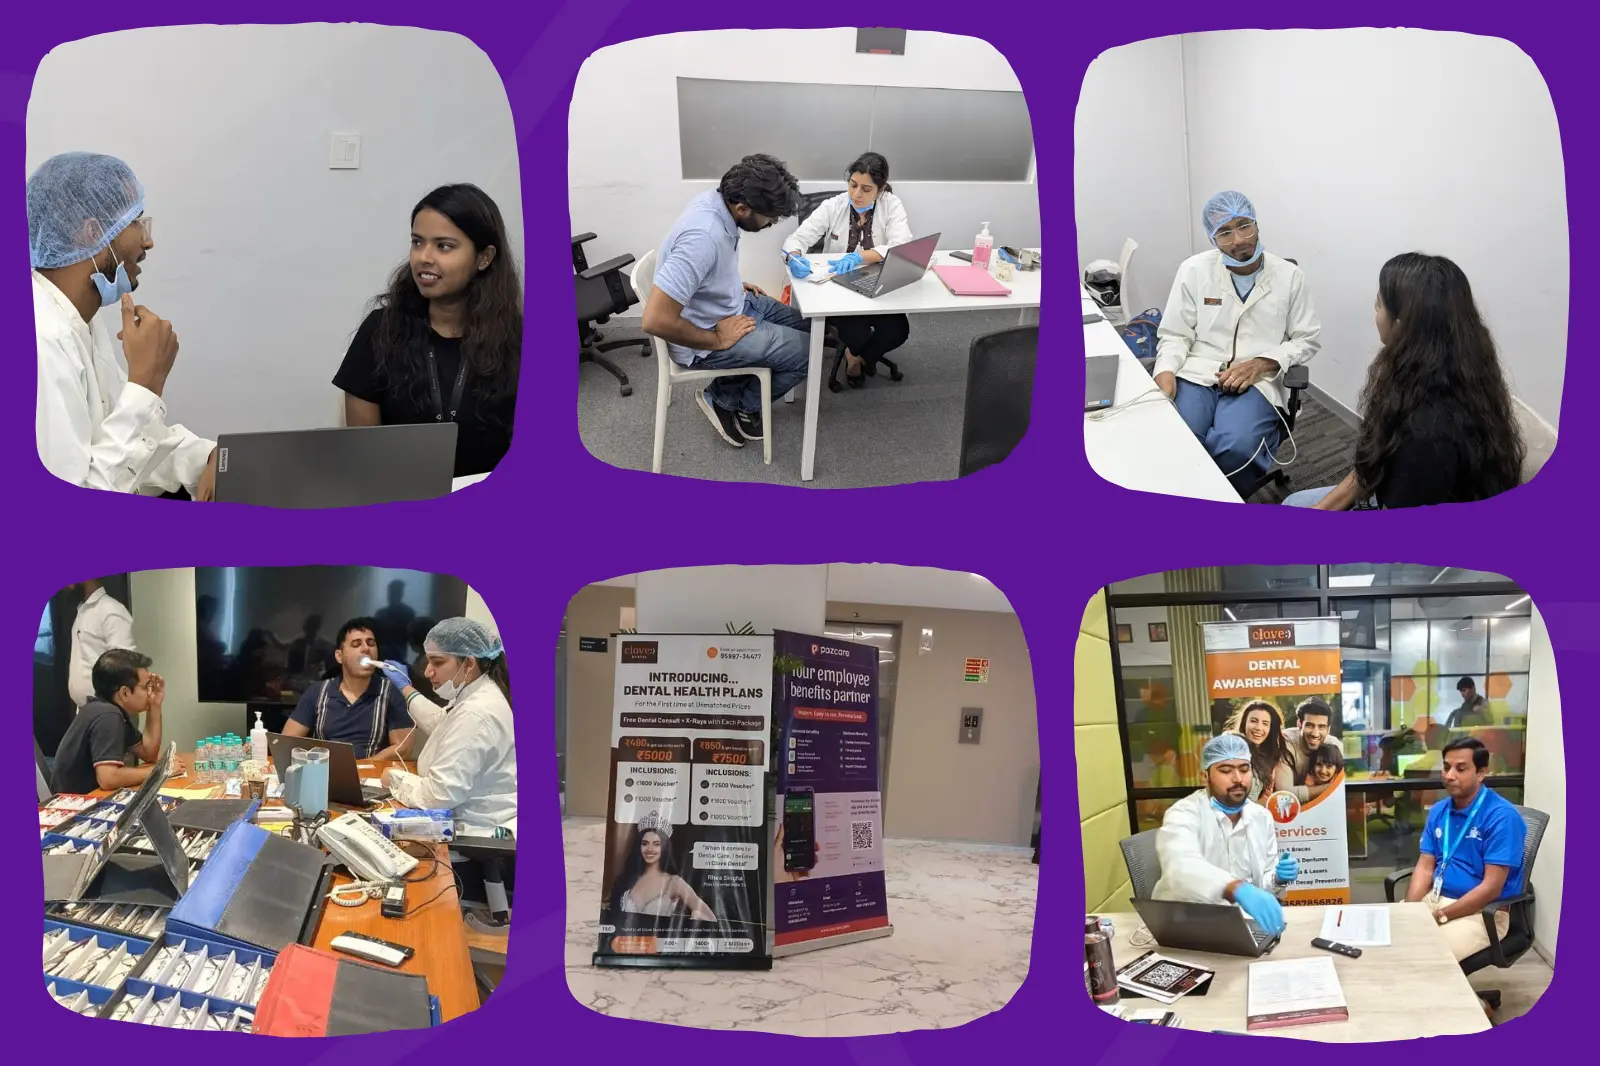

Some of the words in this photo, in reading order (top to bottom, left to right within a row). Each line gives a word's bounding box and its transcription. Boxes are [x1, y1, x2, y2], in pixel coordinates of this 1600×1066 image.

[820, 646, 850, 657] pazcare
[1248, 659, 1300, 671] DENTAL
[649, 672, 739, 684] INTRODUCING...
[817, 668, 870, 687] employee
[1212, 675, 1295, 690] AWARENESS
[1298, 674, 1337, 686] DRIVE
[623, 685, 672, 697] DENTAL
[674, 686, 721, 697] HEALTH
[722, 687, 763, 698] PLANS
[790, 681, 831, 700] benefits
[833, 690, 871, 704] partner
[636, 750, 672, 761] ₹5000
[712, 753, 747, 765] ₹7500
[630, 767, 677, 775] INCLUSIONS:
[705, 769, 751, 777] INCLUSIONS:
